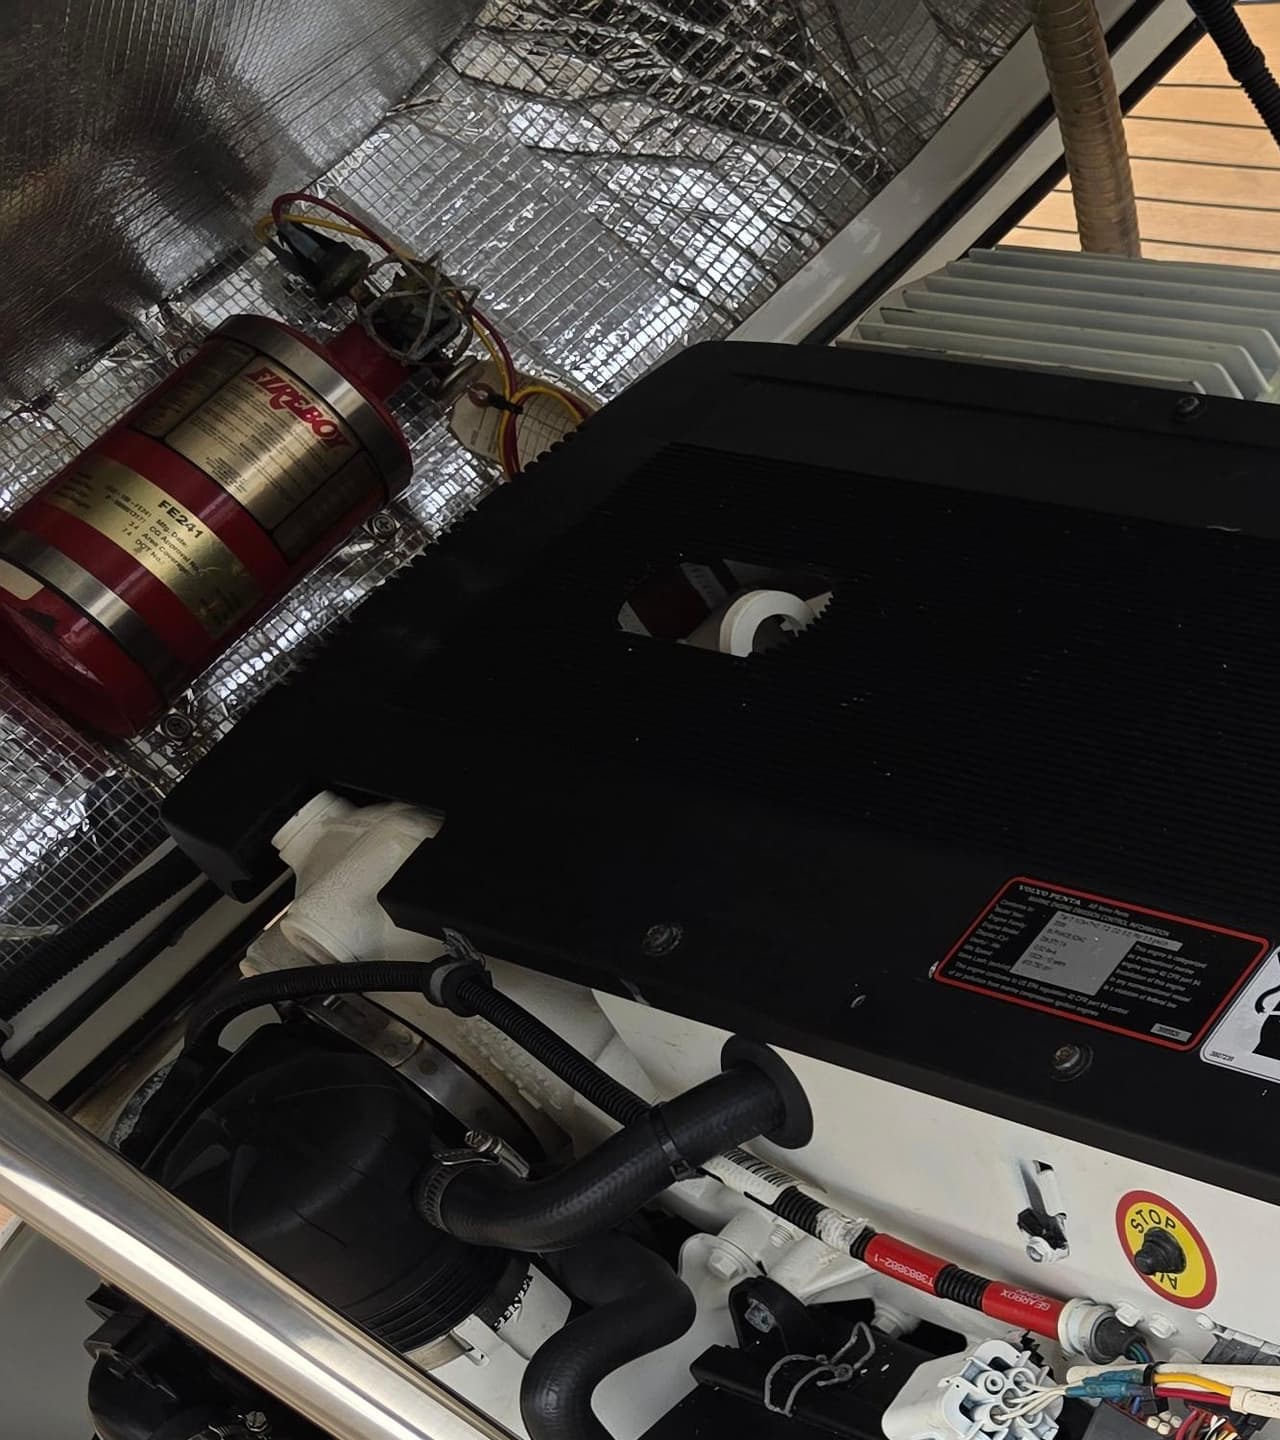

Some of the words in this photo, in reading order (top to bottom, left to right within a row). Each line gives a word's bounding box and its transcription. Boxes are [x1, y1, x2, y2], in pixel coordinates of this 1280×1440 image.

[246, 367, 352, 450] FIREBOY
[158, 500, 203, 538] FE241
[1050, 892, 1082, 906] PENTA
[1130, 1209, 1176, 1233] STOP
[1001, 1290, 1050, 1310] GEARBOX
